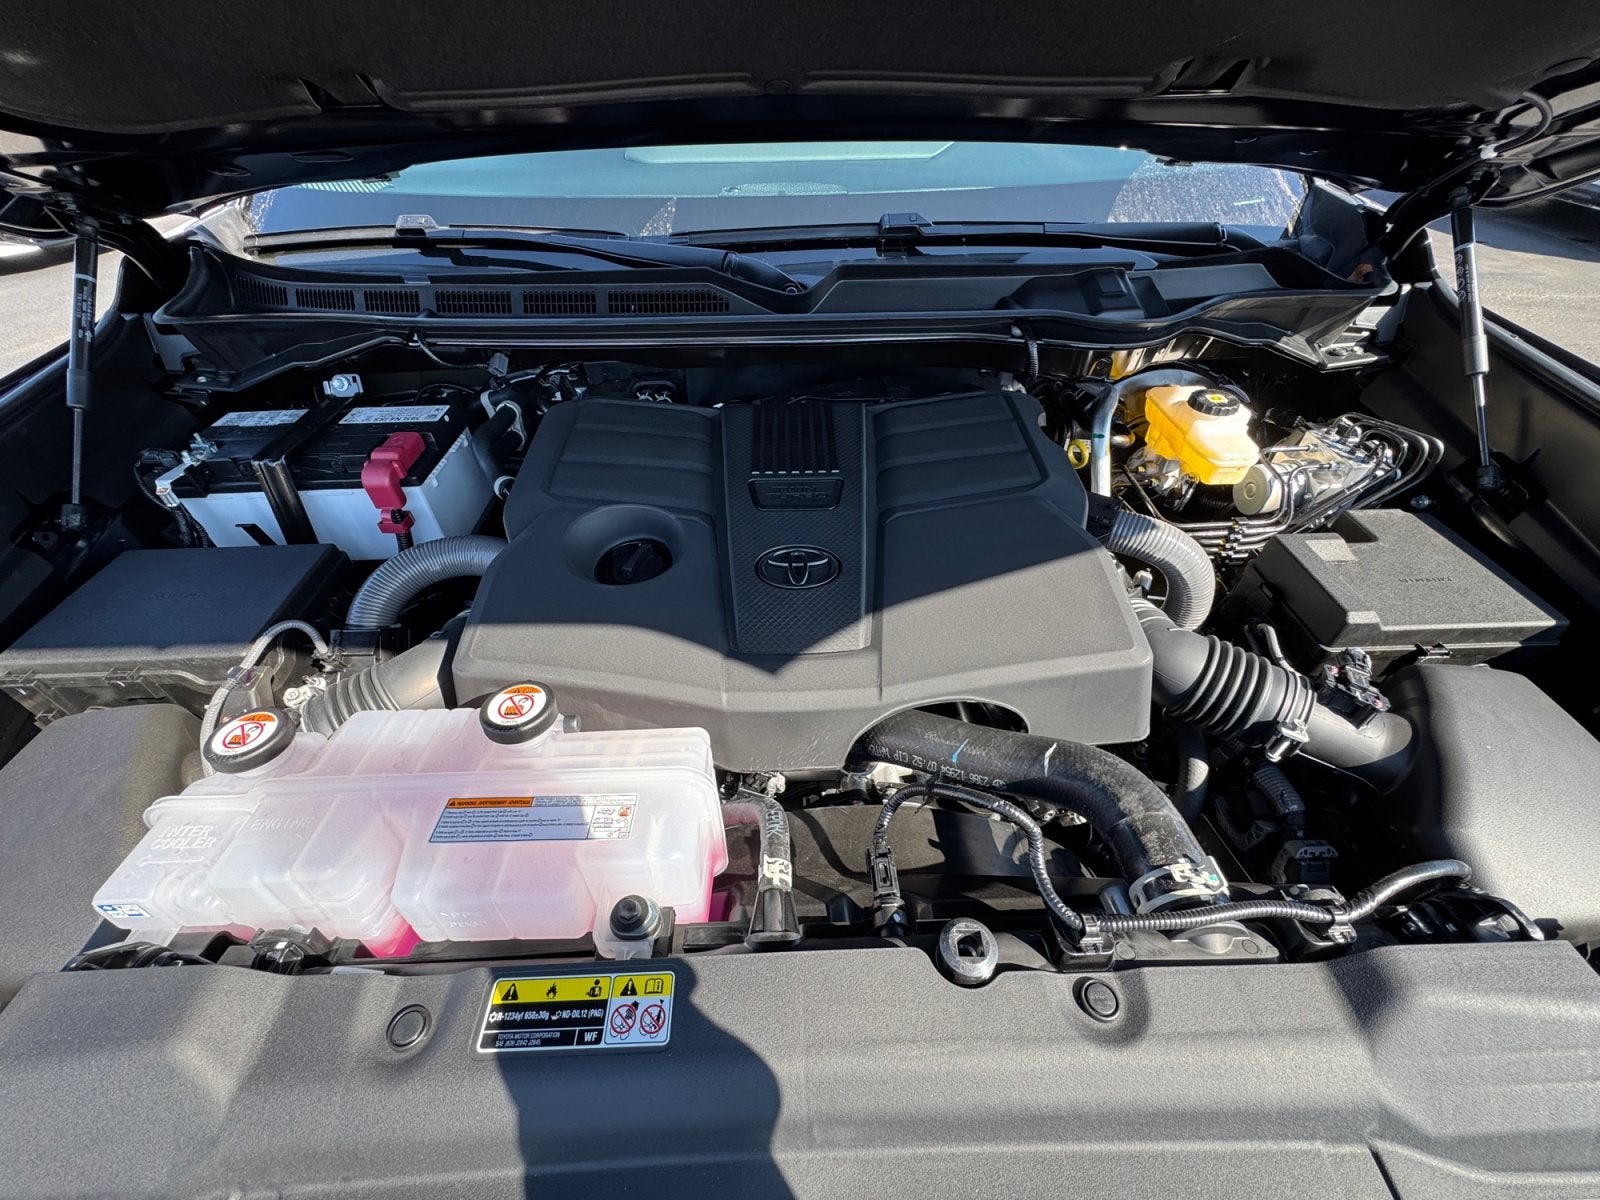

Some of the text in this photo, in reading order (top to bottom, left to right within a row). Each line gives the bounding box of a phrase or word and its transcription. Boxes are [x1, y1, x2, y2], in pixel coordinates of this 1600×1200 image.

[912, 755, 937, 771] 07:52
[251, 816, 314, 830] ENGINE
[160, 824, 214, 838] INTER
[151, 837, 217, 850] COOLER
[530, 1031, 560, 1039] CORPORATION
[584, 1031, 599, 1042] WF
